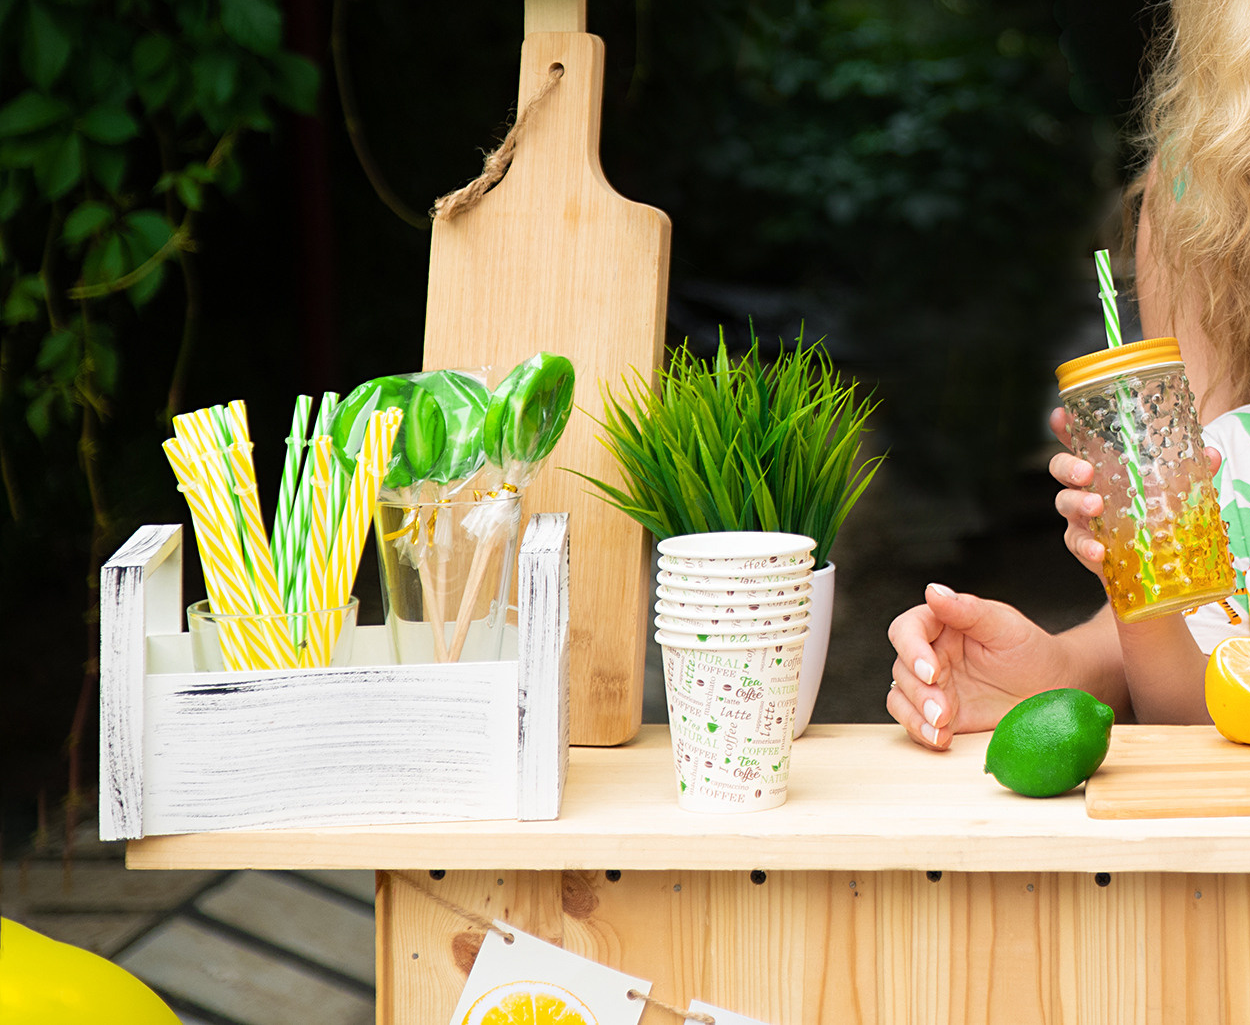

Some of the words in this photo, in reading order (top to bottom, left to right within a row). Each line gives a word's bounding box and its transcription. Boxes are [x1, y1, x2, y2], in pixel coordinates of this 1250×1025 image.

[681, 648, 740, 669] NATURAL
[682, 659, 695, 694] latte
[698, 663, 737, 678] COFFEE
[740, 676, 762, 687] Tea
[720, 706, 752, 720] latte
[760, 701, 776, 736] latte
[724, 722, 739, 757] coffee
[684, 742, 717, 761] COFFEE
[742, 746, 780, 756] COFFEE
[738, 755, 760, 767] Tea
[700, 786, 745, 804] COFFEE
